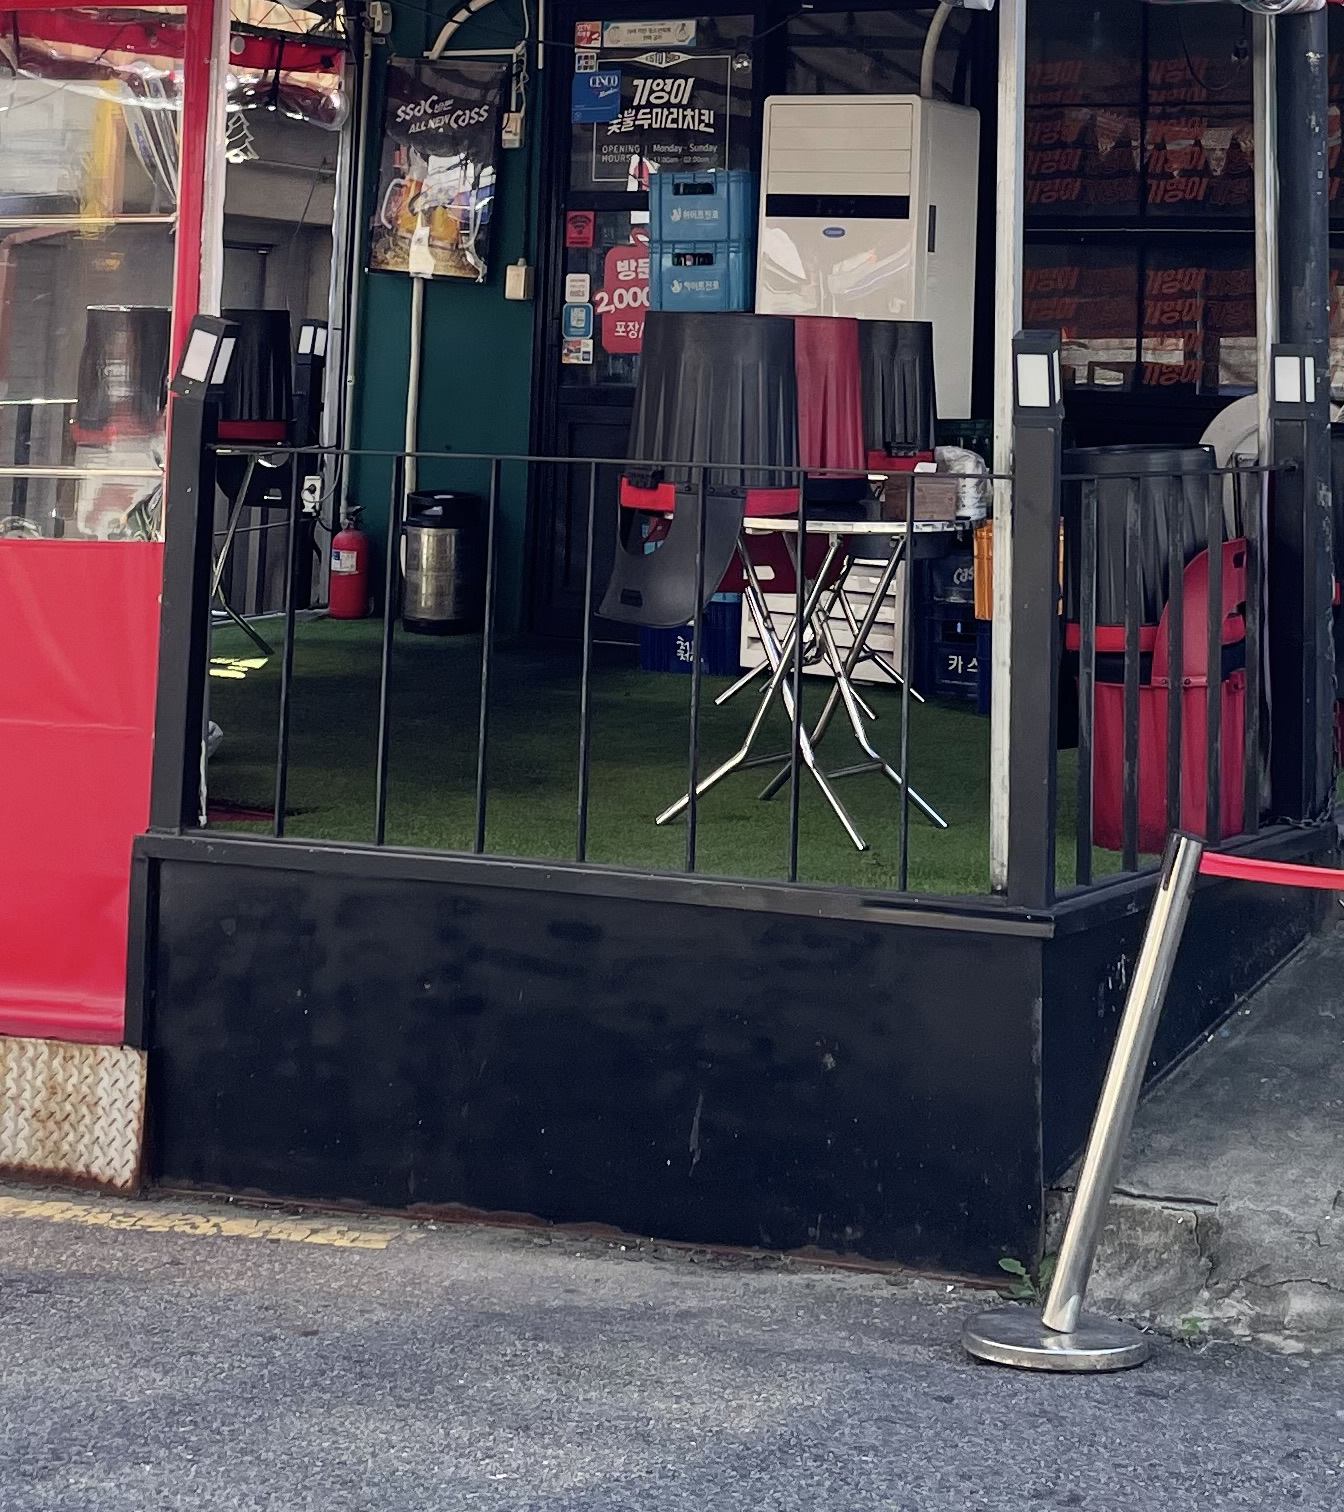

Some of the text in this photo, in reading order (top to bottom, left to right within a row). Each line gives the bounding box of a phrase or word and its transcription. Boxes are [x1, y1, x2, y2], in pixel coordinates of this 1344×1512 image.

[632, 77, 696, 106] 기영이
[408, 121, 426, 134] ALL
[602, 144, 640, 153] OPENING
[653, 144, 682, 154] Monday
[689, 142, 718, 153] Sunday
[953, 566, 974, 584] Cas
